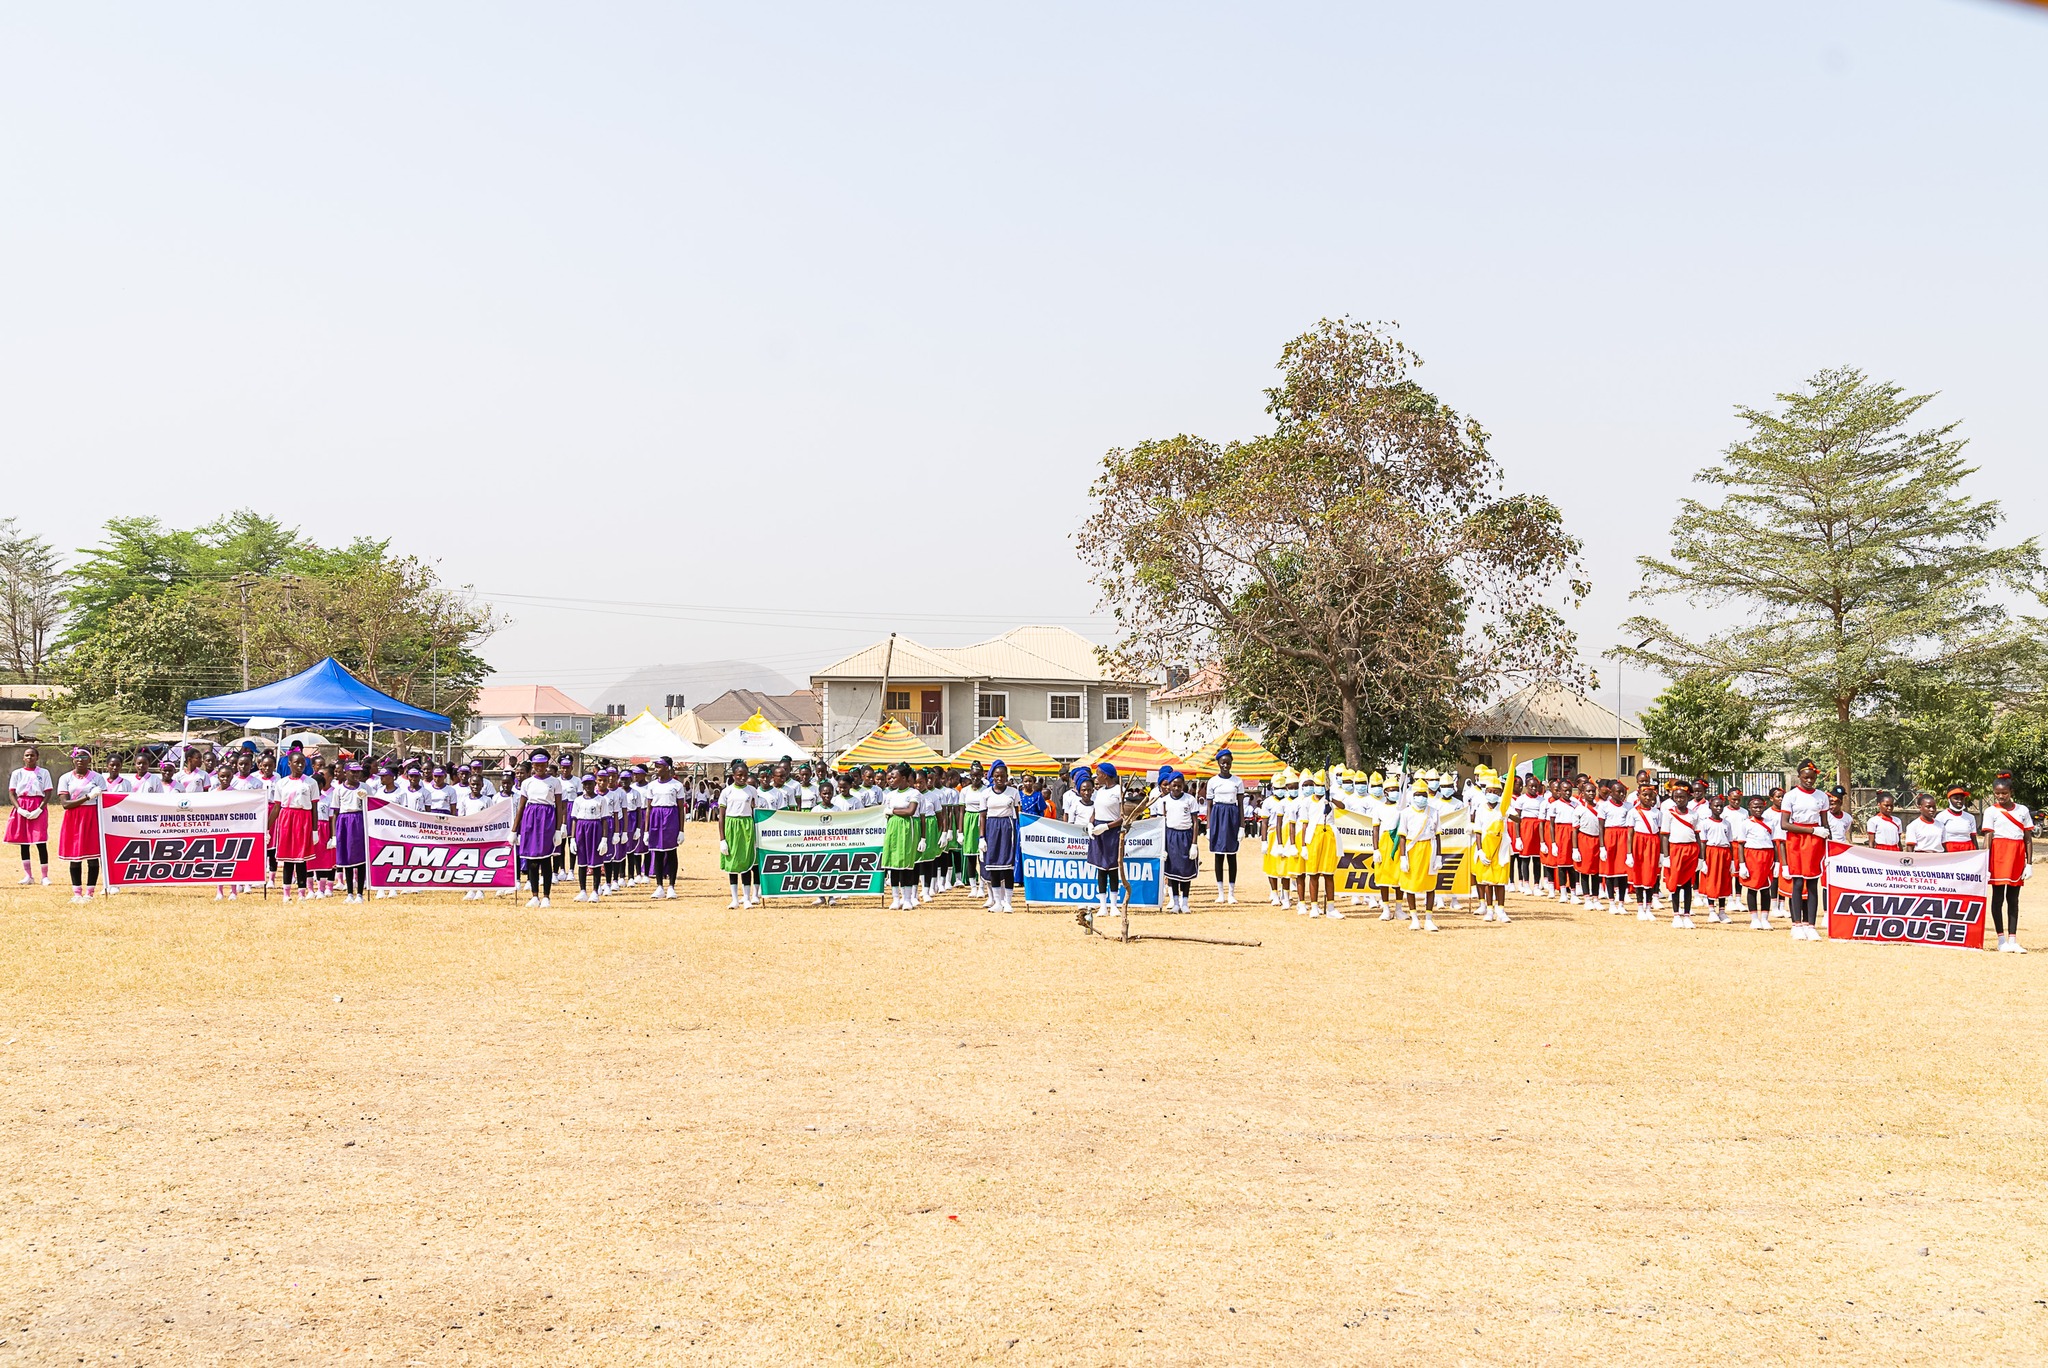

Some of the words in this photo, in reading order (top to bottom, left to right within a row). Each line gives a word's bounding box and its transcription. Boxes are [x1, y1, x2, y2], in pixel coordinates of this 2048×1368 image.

[374, 819, 396, 827] MODEL
[420, 822, 442, 830] JUNIOR
[484, 822, 510, 831] SCHOOL
[115, 838, 255, 863] ABAJI
[372, 845, 511, 868] AMAC
[124, 862, 236, 880] HOUSE
[386, 869, 496, 883] HOUSE
[1836, 865, 1860, 874] MODEL
[1913, 871, 1954, 879] SECONDARY
[1956, 873, 1982, 882] SCHOOL
[781, 874, 873, 892] HOUSE
[1054, 883, 1123, 900] HOU
[1834, 893, 1983, 923] KWALI
[1853, 917, 1967, 943] HOUSE
